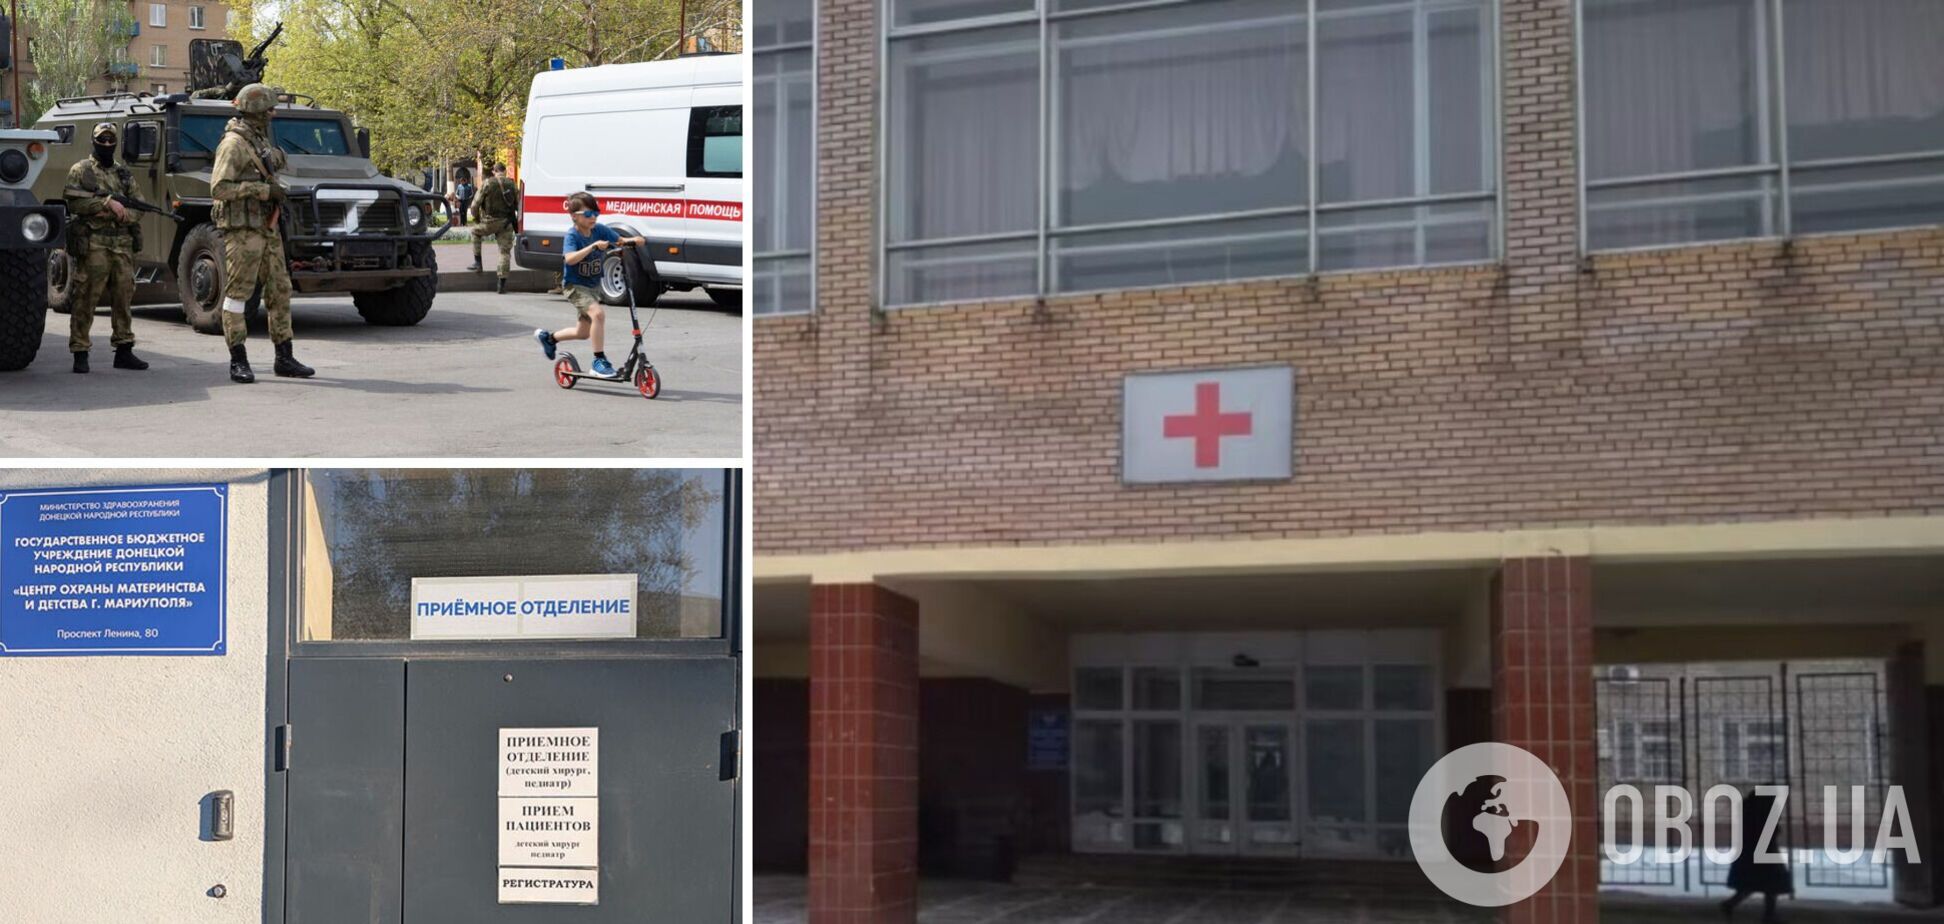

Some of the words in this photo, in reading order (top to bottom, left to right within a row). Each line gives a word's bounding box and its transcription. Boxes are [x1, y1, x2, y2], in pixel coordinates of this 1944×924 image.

[606, 201, 681, 215] МЕДИЦИНСКАЯ
[689, 204, 741, 219] ПОМОЩЬ
[40, 503, 101, 511] МИНИСТЕРСТВО
[103, 500, 180, 509] ЗДРАВООХРАНЕНИЯ
[39, 512, 82, 521] ДОНЕЦКОЙ
[83, 511, 127, 520] НАРОДНОЙ
[129, 510, 180, 518] РЕСПУБЛИКИ
[15, 535, 123, 548] ГОСУДАРСТВЕННОЕ
[126, 533, 205, 545] БЮДЖЕТНОЕ
[34, 550, 112, 561] УЧРЕЖДЕНИЕ
[115, 546, 185, 559] ДОНЕЦКОЙ
[34, 561, 102, 574] НАРОДНОЙ
[105, 562, 184, 573] РЕСПУБЛИКИ
[14, 585, 57, 597] «ЦЕНТР
[60, 584, 113, 595] ОХРАНЫ
[116, 582, 206, 594] МАТЕРИНСТВА
[25, 600, 35, 610] И
[38, 600, 87, 611] ДЕТСТВА
[91, 599, 101, 610] Г.
[104, 598, 193, 609] МАРИУПОЛЯ»
[417, 599, 517, 616] ПРИЁМНОЕ
[521, 599, 630, 617] ОТДЕЛЕНИЕ
[57, 630, 101, 640] Проспект
[103, 629, 142, 639] Ленина,
[145, 629, 159, 638] 80
[507, 736, 591, 748] ПРИЕМНОЕ
[507, 752, 590, 763] ОТДЕЛЕНИЕ
[505, 766, 550, 776] (детский
[552, 767, 591, 776] хирург,
[524, 780, 572, 790] педиатр)
[522, 805, 575, 817] ПРИЕМ
[506, 821, 591, 833] ПАЦИЕНТОВ
[551, 841, 580, 849] хирург
[530, 851, 566, 860] педиатр
[502, 878, 594, 890] РЕГИСТРАТУРА
